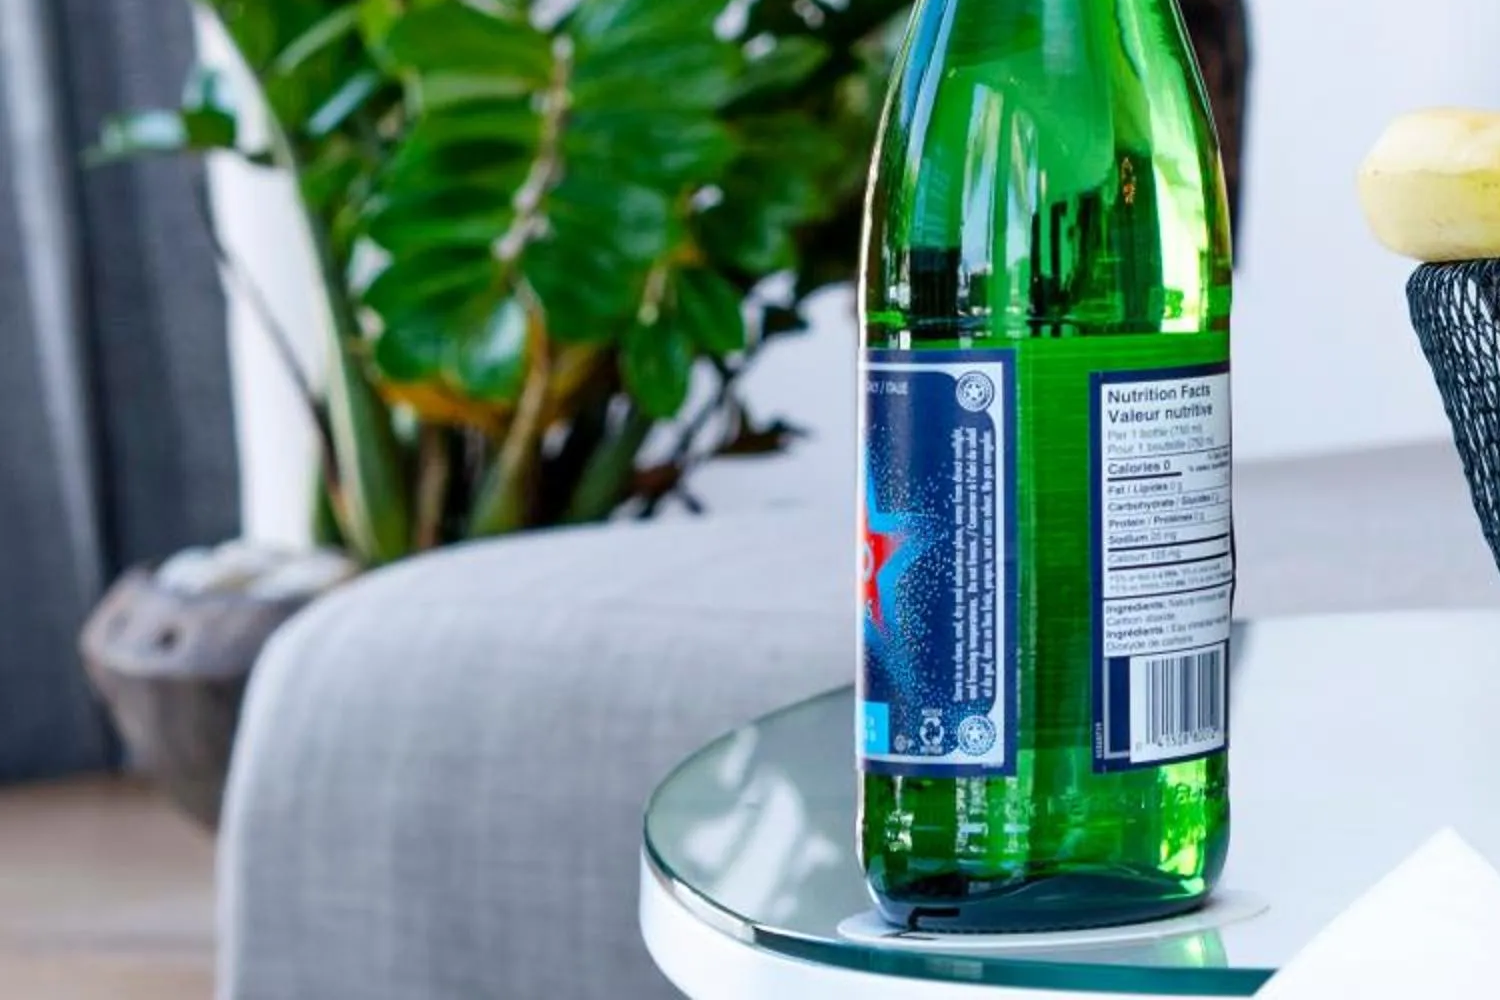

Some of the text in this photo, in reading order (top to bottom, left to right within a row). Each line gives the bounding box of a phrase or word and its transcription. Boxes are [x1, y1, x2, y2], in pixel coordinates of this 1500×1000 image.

[1108, 384, 1211, 404] Nutrition Facts
[1108, 403, 1214, 424] Valeur nutritive
[1108, 460, 1171, 475] Calories 0
